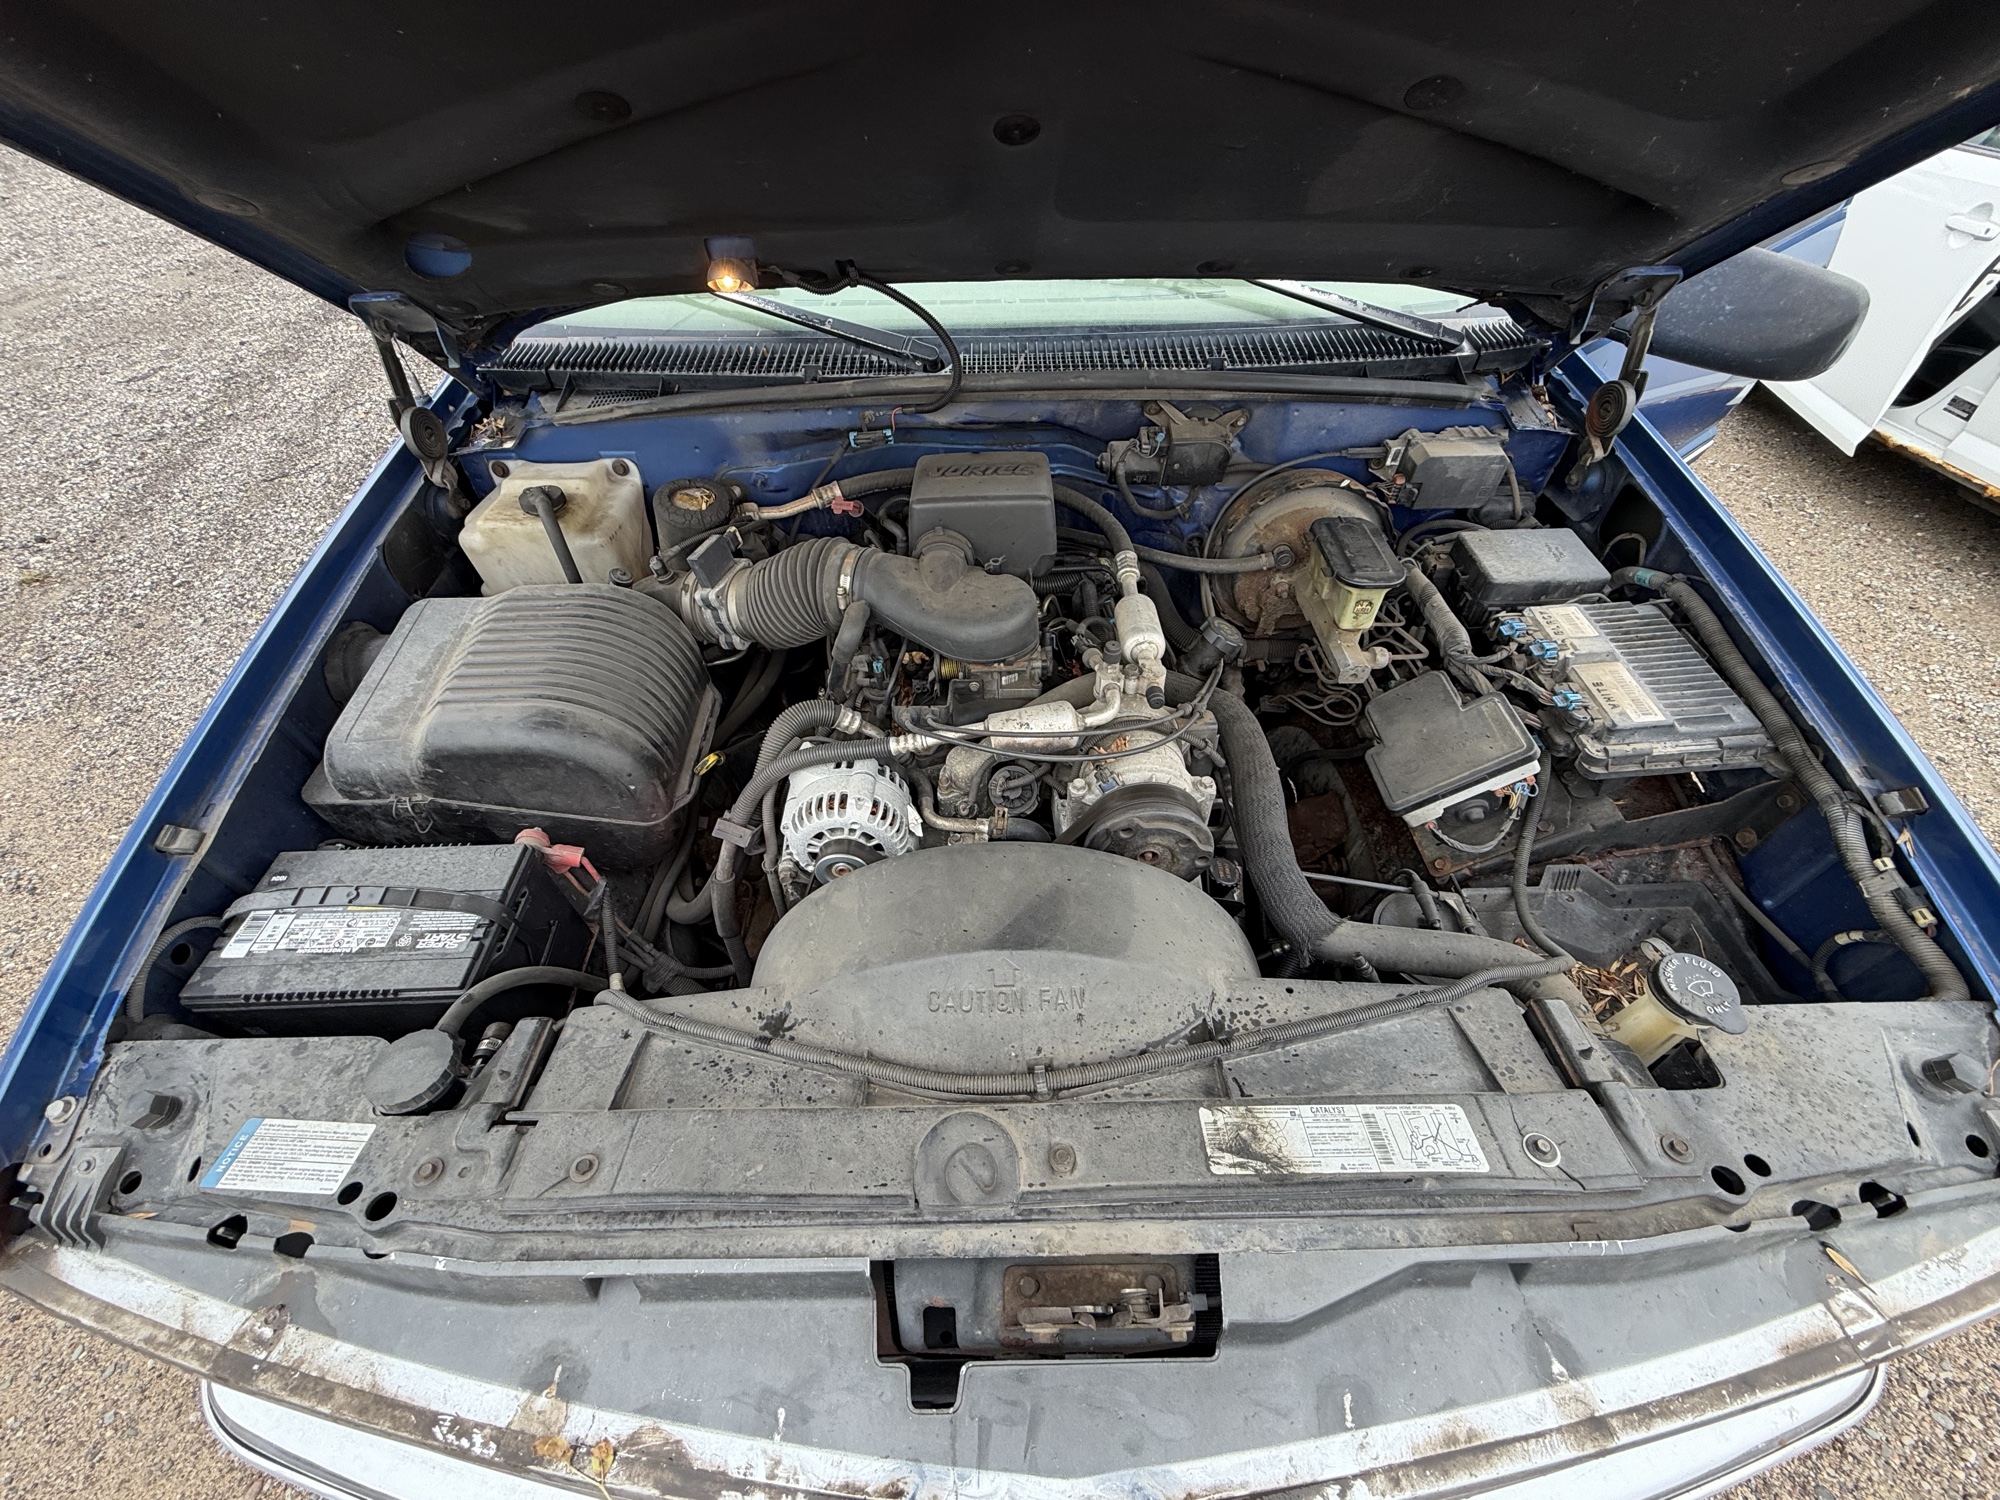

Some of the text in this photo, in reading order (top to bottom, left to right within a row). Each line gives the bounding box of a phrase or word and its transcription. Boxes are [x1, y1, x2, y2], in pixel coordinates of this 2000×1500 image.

[1592, 681, 1621, 710] WHITE
[415, 940, 459, 949] SUPER
[1663, 956, 1722, 991] WASHER FLUID
[927, 986, 1085, 1014] CAUTION FAN
[1706, 1000, 1732, 1014] ONLY
[1310, 1106, 1346, 1114] CATALYST
[215, 1133, 249, 1173] NOTICE
